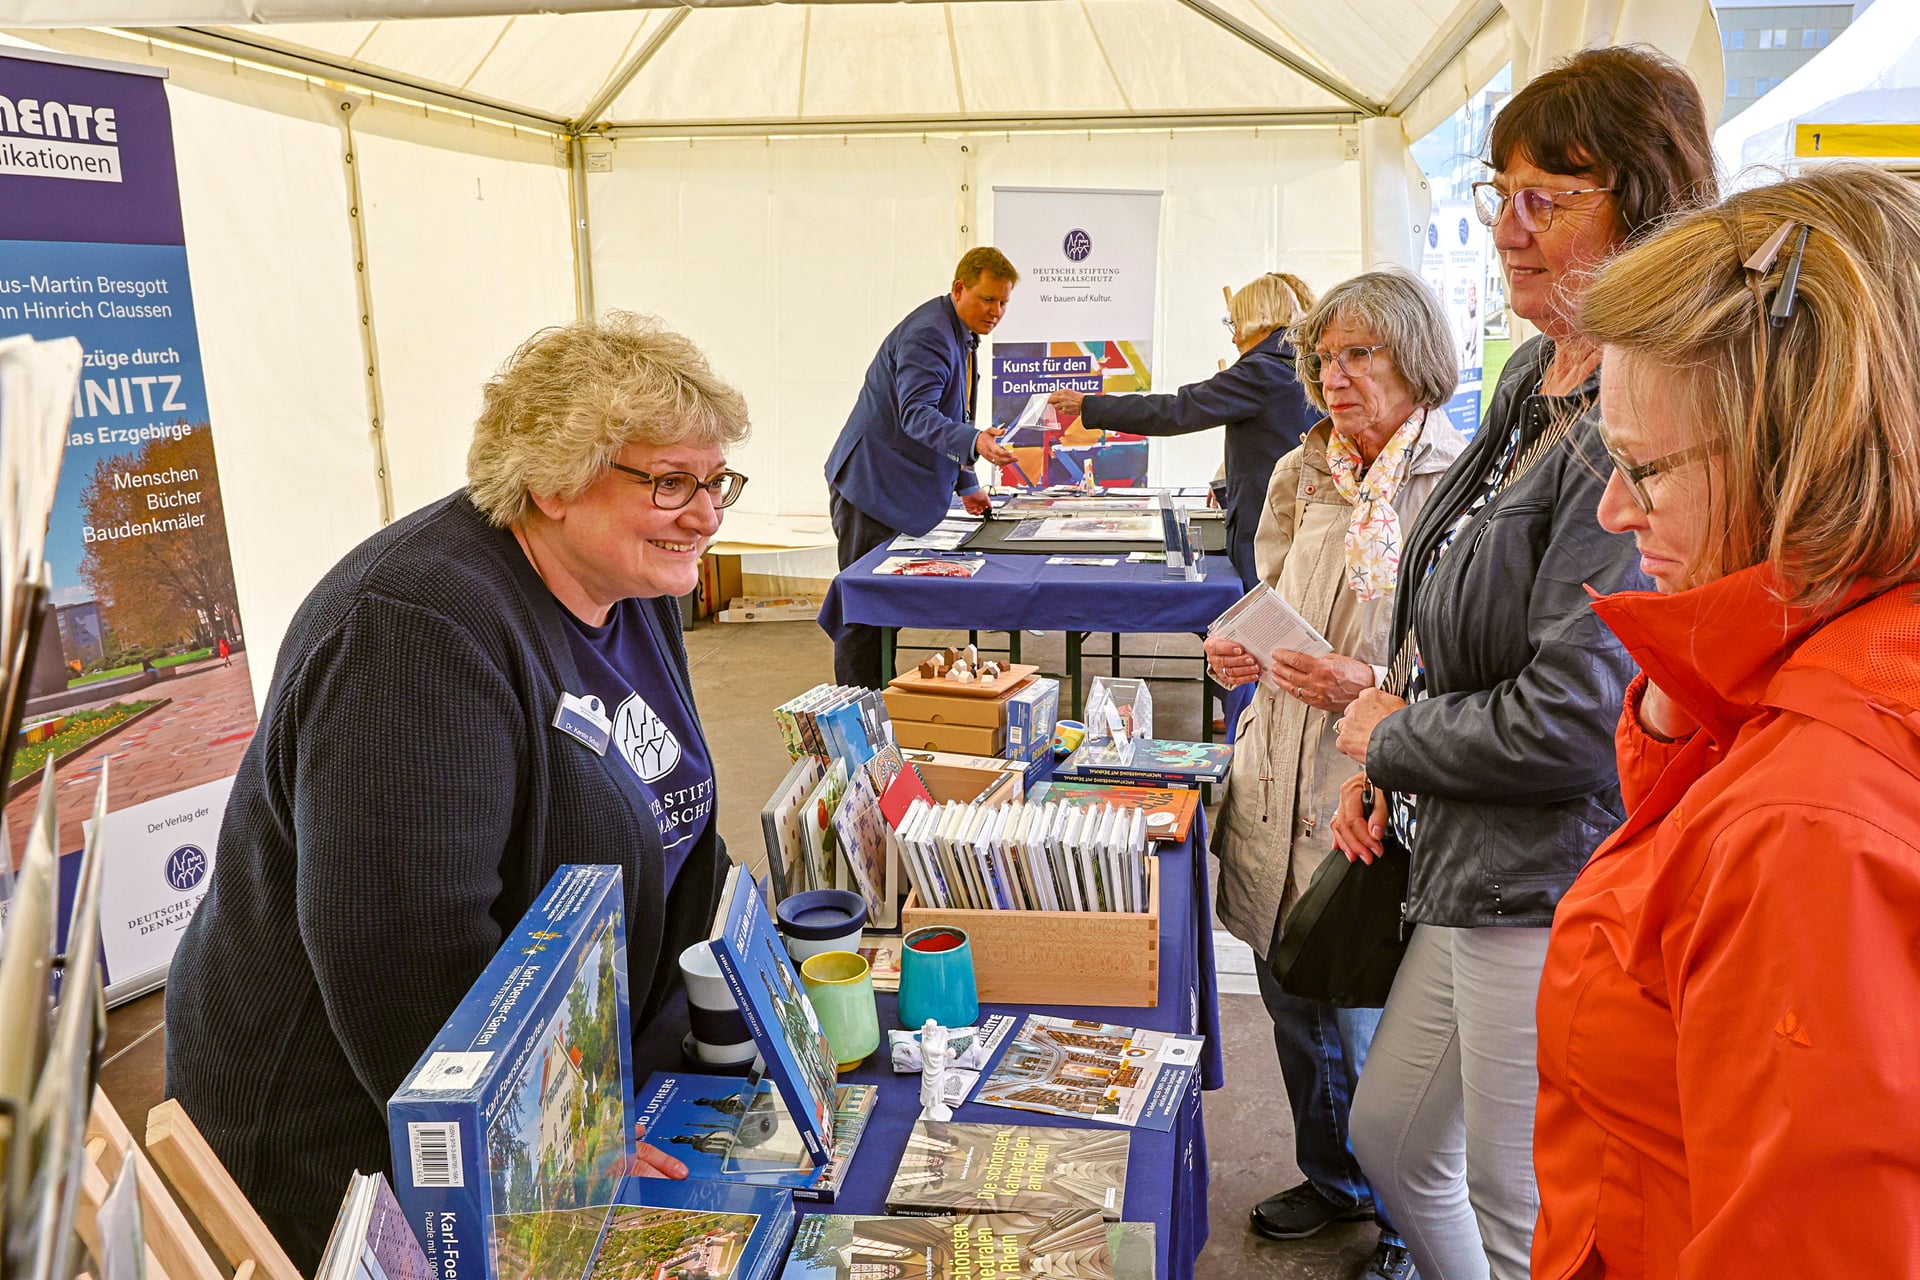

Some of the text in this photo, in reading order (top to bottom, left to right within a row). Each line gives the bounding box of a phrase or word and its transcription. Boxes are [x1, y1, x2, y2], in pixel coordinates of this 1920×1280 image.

[1812, 132, 1821, 151] 1
[0, 143, 112, 175] ikationen
[97, 276, 169, 298] Bresgott
[1040, 294, 1112, 303] Wir bauen auf Kultur.
[23, 301, 94, 319] Hinrich
[98, 301, 172, 319] Claussen
[82, 347, 180, 370] züge durch
[1002, 358, 1087, 373] Kunst für den
[1002, 378, 1099, 393] Denkmalschutz
[97, 422, 192, 445] Erzgebirge
[114, 467, 199, 490] Menschen
[146, 489, 202, 511] Bücher
[82, 512, 206, 543] Baudenkmäler
[147, 807, 209, 833] Der Verlag der
[128, 898, 191, 929] DEUTSCHE
[140, 907, 198, 936] DENKMA
[476, 965, 541, 1045] Karl-Foerster-Garten
[485, 1017, 545, 1122] Karl-Foerster-Garten
[644, 1078, 676, 1113] LUTHERS
[976, 1131, 1012, 1200] Die schönsten
[1000, 1136, 1031, 1196] Kathedralen
[1028, 1144, 1050, 1191] am Rhein
[425, 1211, 436, 1238] Puzzle
[427, 1240, 437, 1254] mit
[997, 1235, 1020, 1272] Rhein
